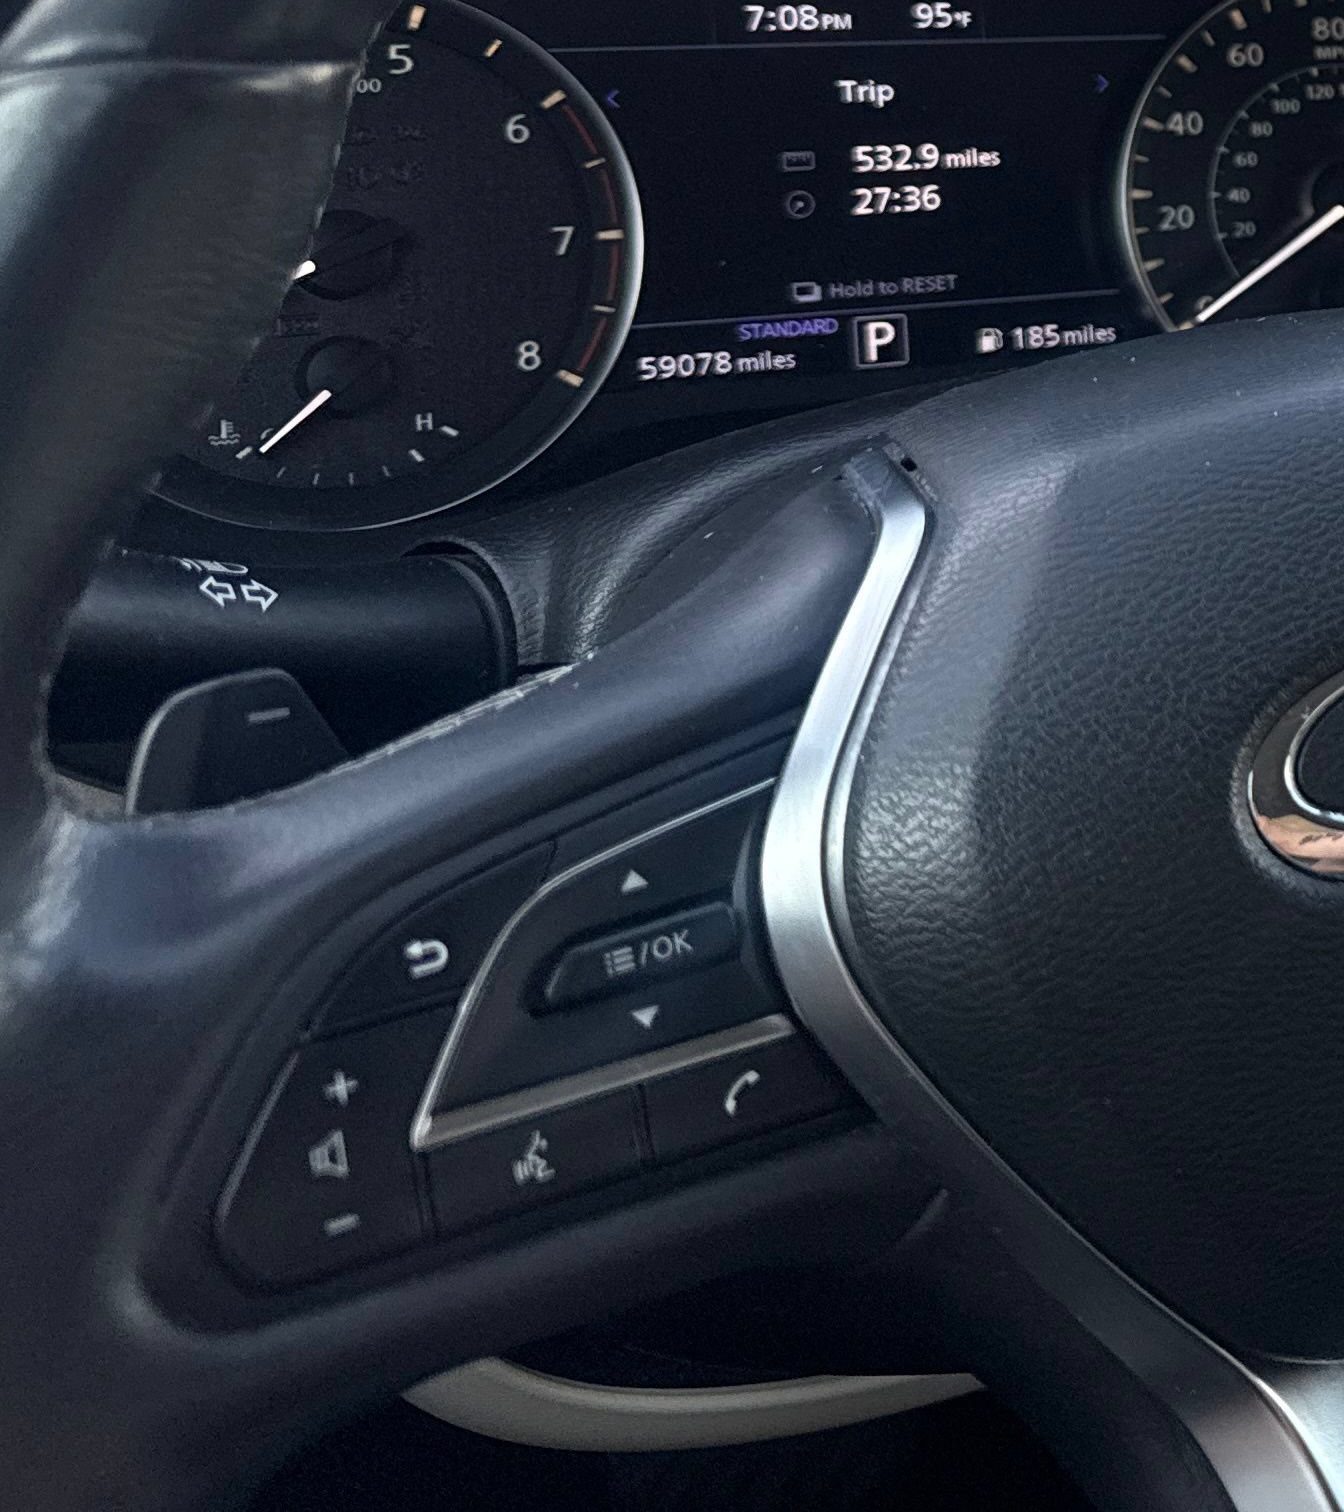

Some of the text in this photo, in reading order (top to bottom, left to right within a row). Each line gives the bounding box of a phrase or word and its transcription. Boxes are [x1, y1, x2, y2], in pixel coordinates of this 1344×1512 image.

[387, 44, 414, 75] 5
[1226, 43, 1264, 67] 60
[834, 79, 895, 108] Trip
[1305, 84, 1335, 101] 120
[1270, 97, 1300, 114] 100
[505, 114, 530, 144] 6
[1165, 111, 1203, 136] 40
[1249, 121, 1273, 137] 80
[851, 144, 1000, 172] 532.9 miles
[1234, 151, 1258, 168] 60
[850, 185, 941, 215] 27:36
[1226, 187, 1251, 204] 40
[1159, 205, 1195, 230] 20
[1232, 221, 1256, 238] 20
[550, 226, 574, 257] 7
[829, 274, 957, 298] Hold to RESET
[737, 317, 838, 341] STANDARD
[863, 321, 894, 361] P
[1010, 323, 1117, 349] 185 miles
[517, 340, 541, 371] 8
[637, 350, 796, 381] 59078 miles
[416, 413, 433, 431] H
